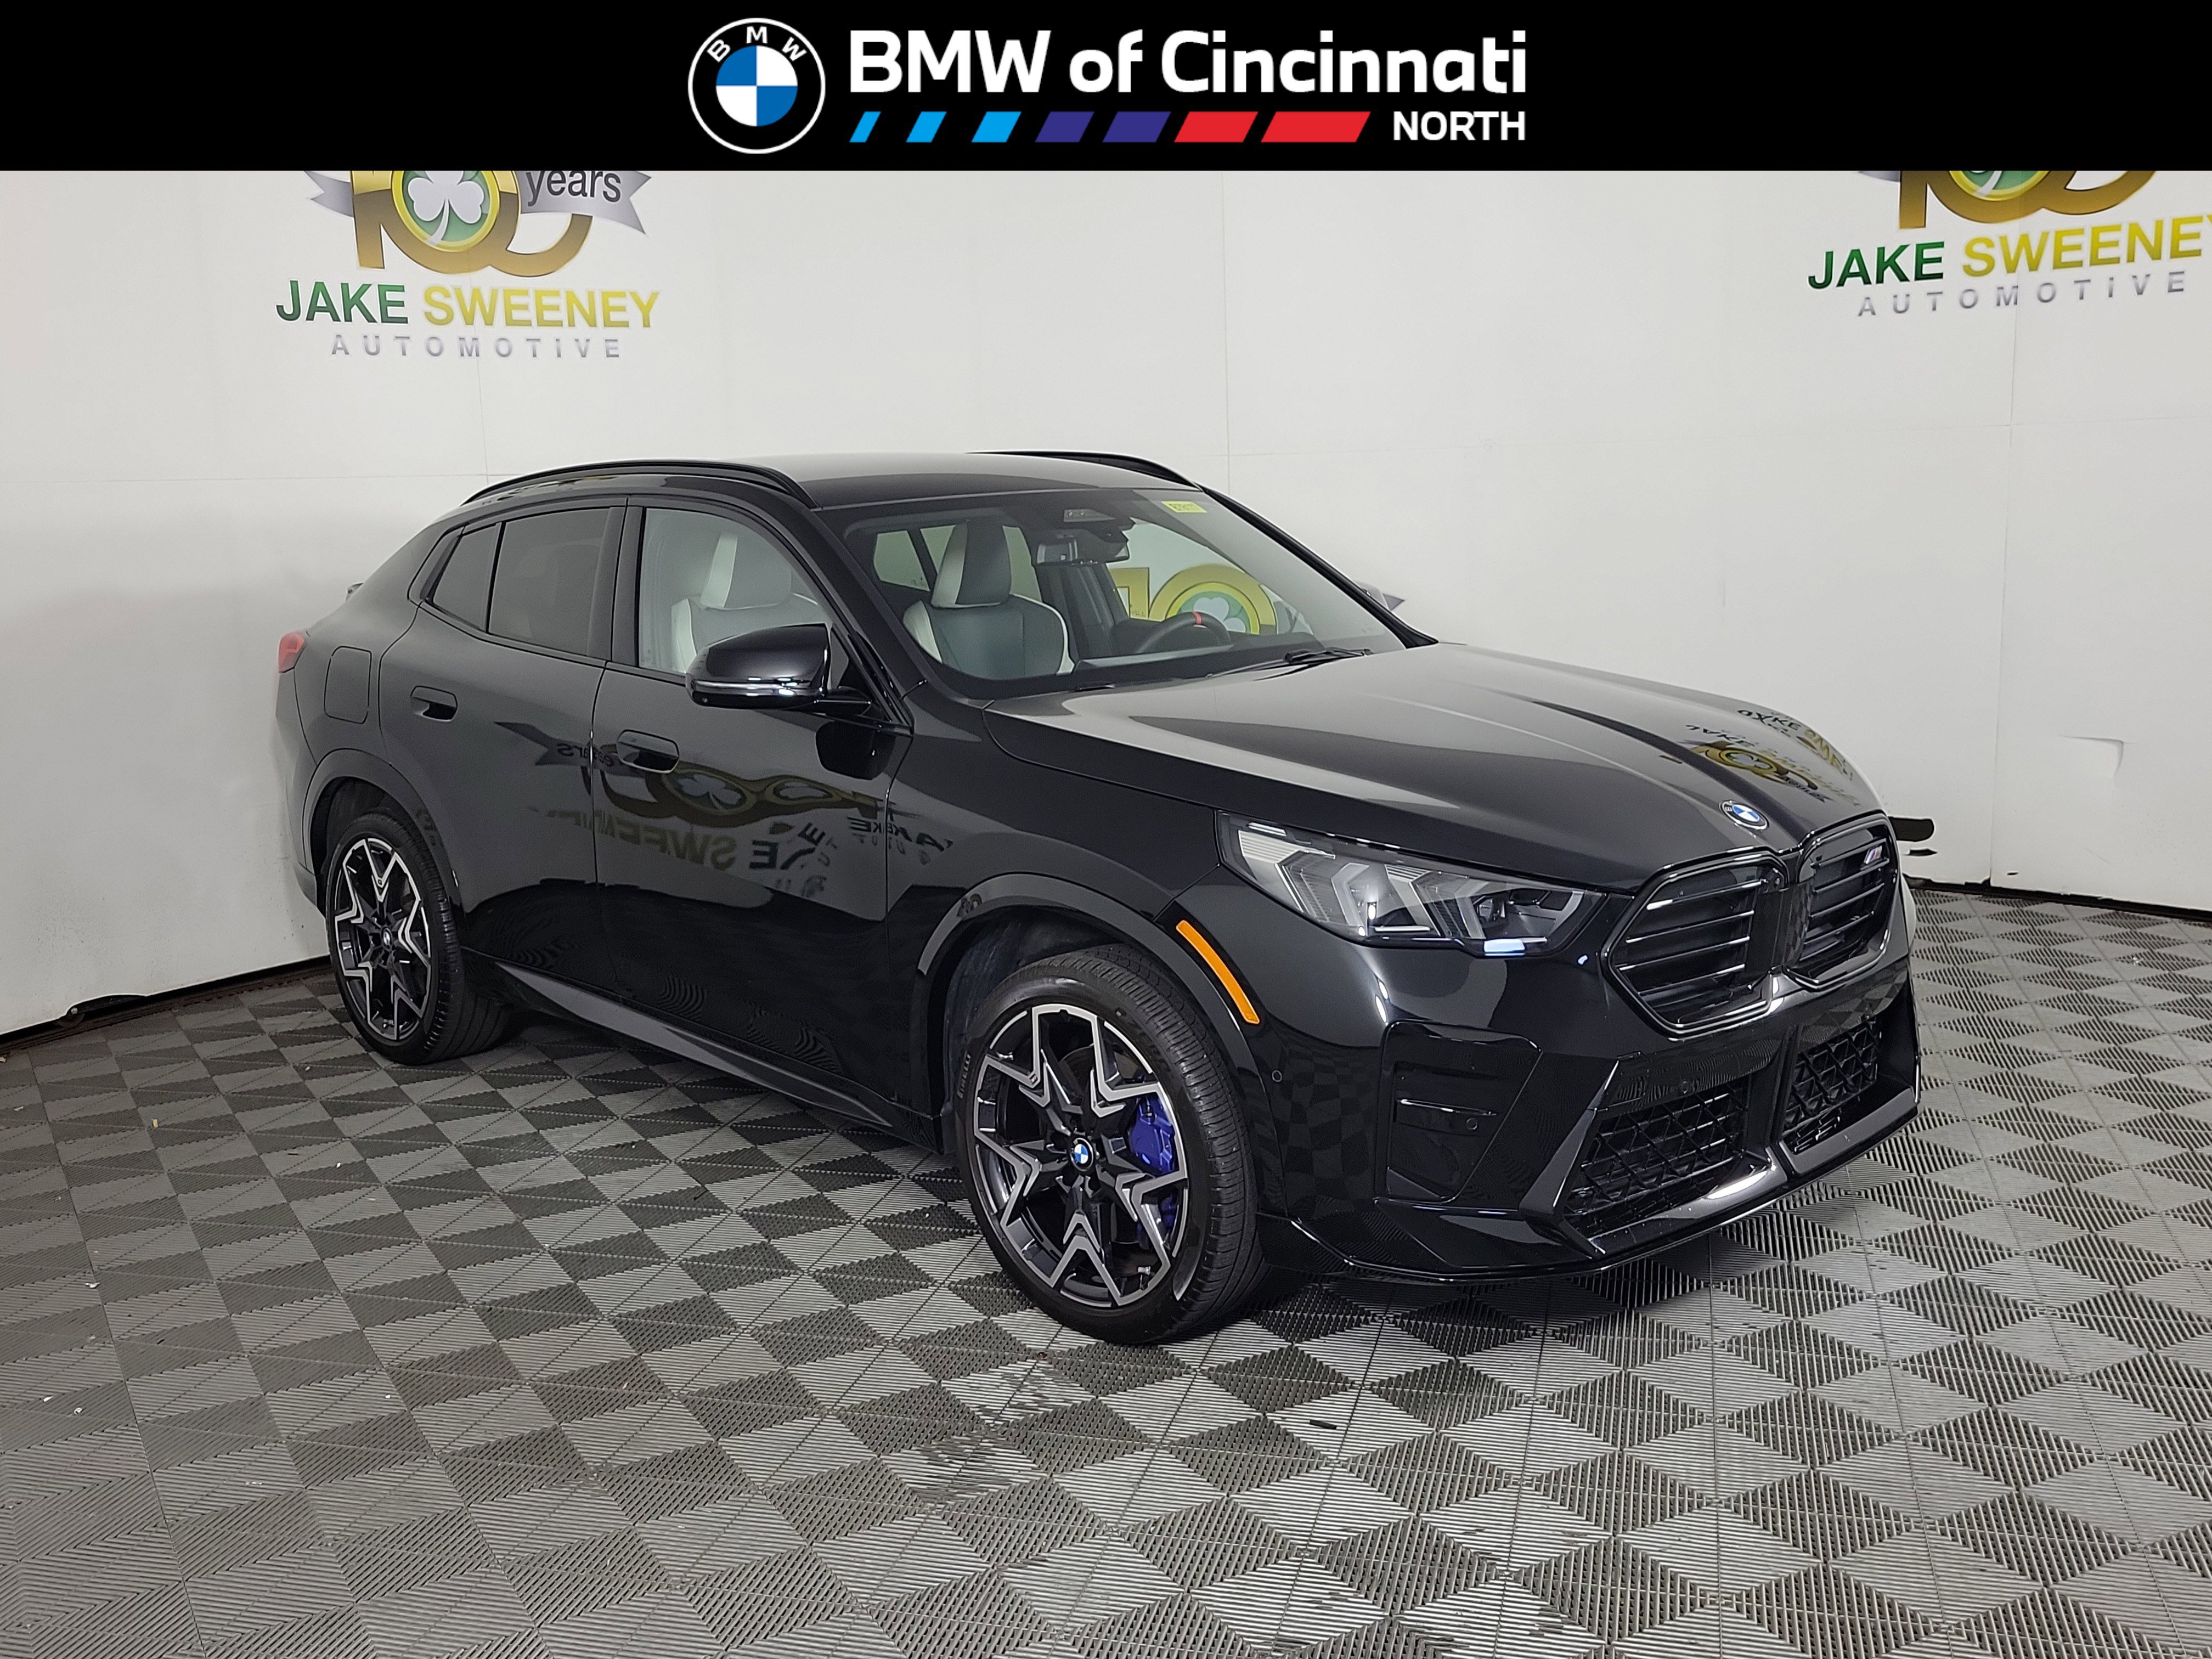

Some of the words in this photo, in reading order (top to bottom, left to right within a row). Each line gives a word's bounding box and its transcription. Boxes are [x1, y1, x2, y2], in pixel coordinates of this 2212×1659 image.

[525, 171, 622, 207] years
[1808, 241, 1945, 289] JAKE
[1962, 214, 2212, 277] SWEENE
[276, 280, 409, 324] JAKE
[422, 284, 660, 328] SWEENEY
[1858, 270, 2186, 317] AUTOMOTIVE
[331, 334, 620, 358] AUTOMOTIVE
